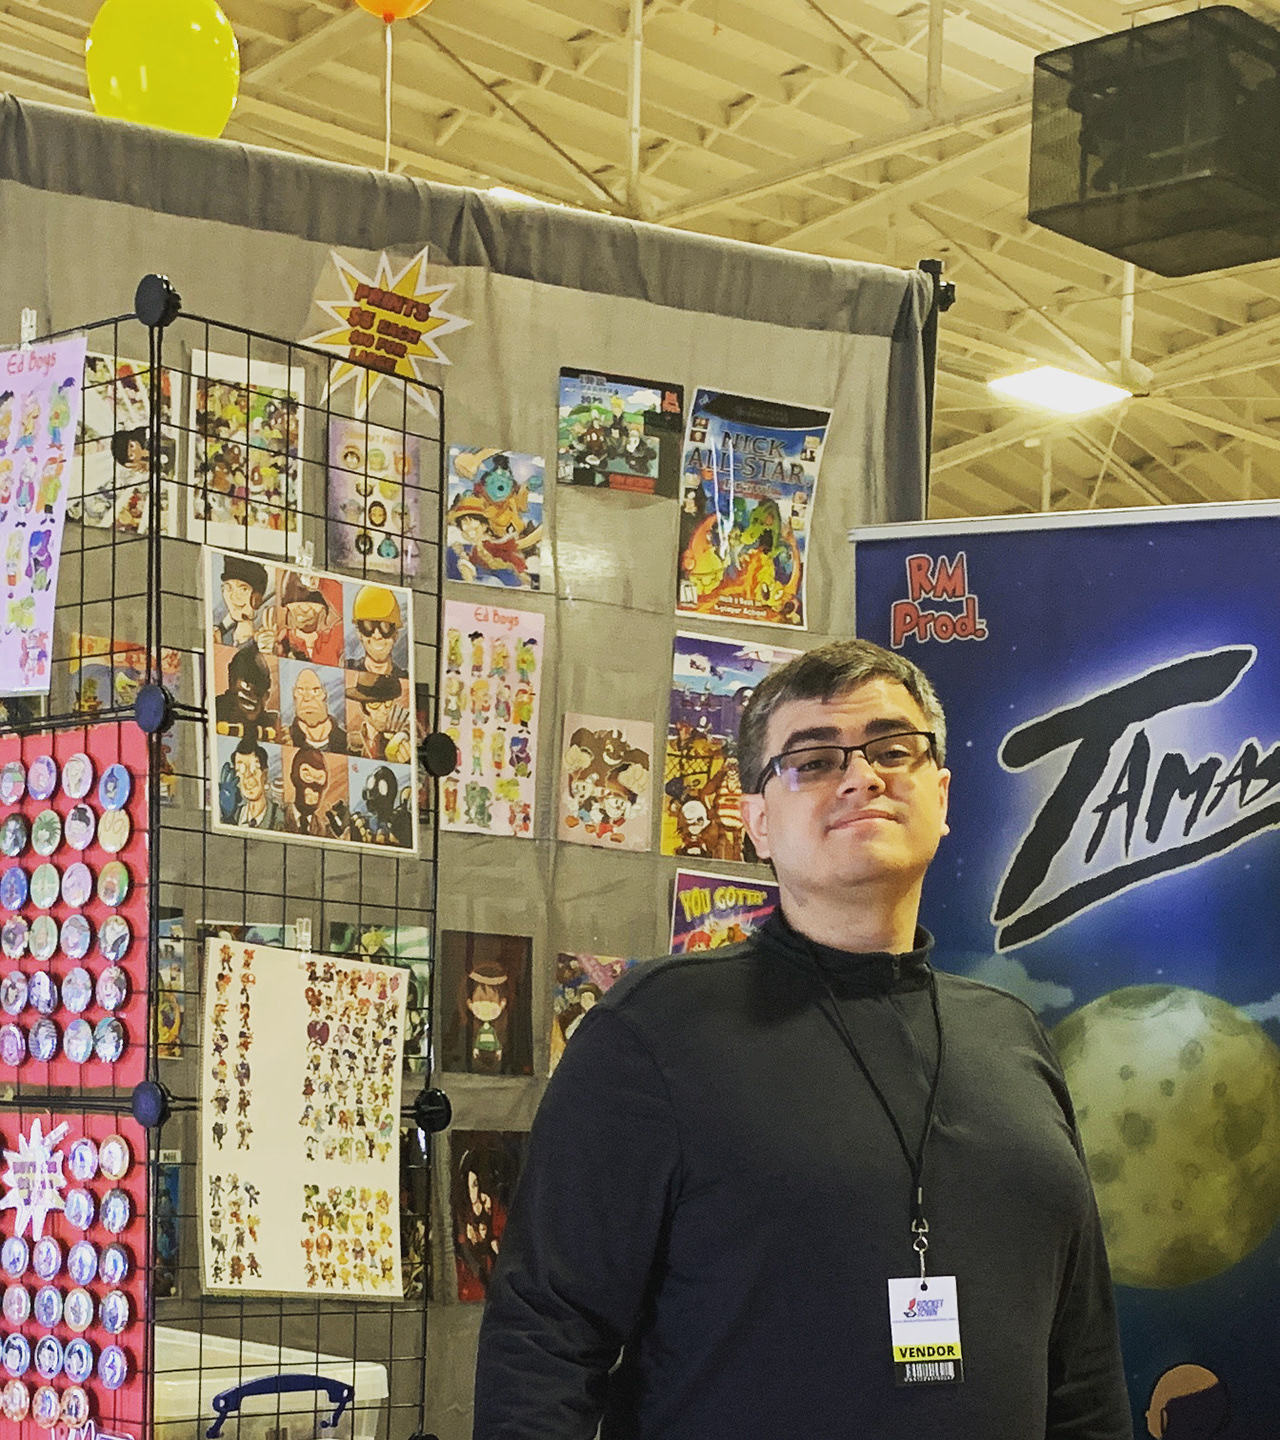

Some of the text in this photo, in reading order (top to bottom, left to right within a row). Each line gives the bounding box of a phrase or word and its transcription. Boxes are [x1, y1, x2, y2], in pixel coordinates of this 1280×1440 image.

[354, 283, 431, 322] PRINTS
[6, 350, 57, 377] Ed Boys
[722, 430, 787, 457] NICK
[687, 447, 805, 486] ALL-STAR
[907, 553, 966, 602] RM
[474, 608, 521, 629] Ed Boys
[891, 596, 988, 649] Prod.
[680, 887, 714, 922] YOU
[899, 1345, 956, 1359] VENDOR
